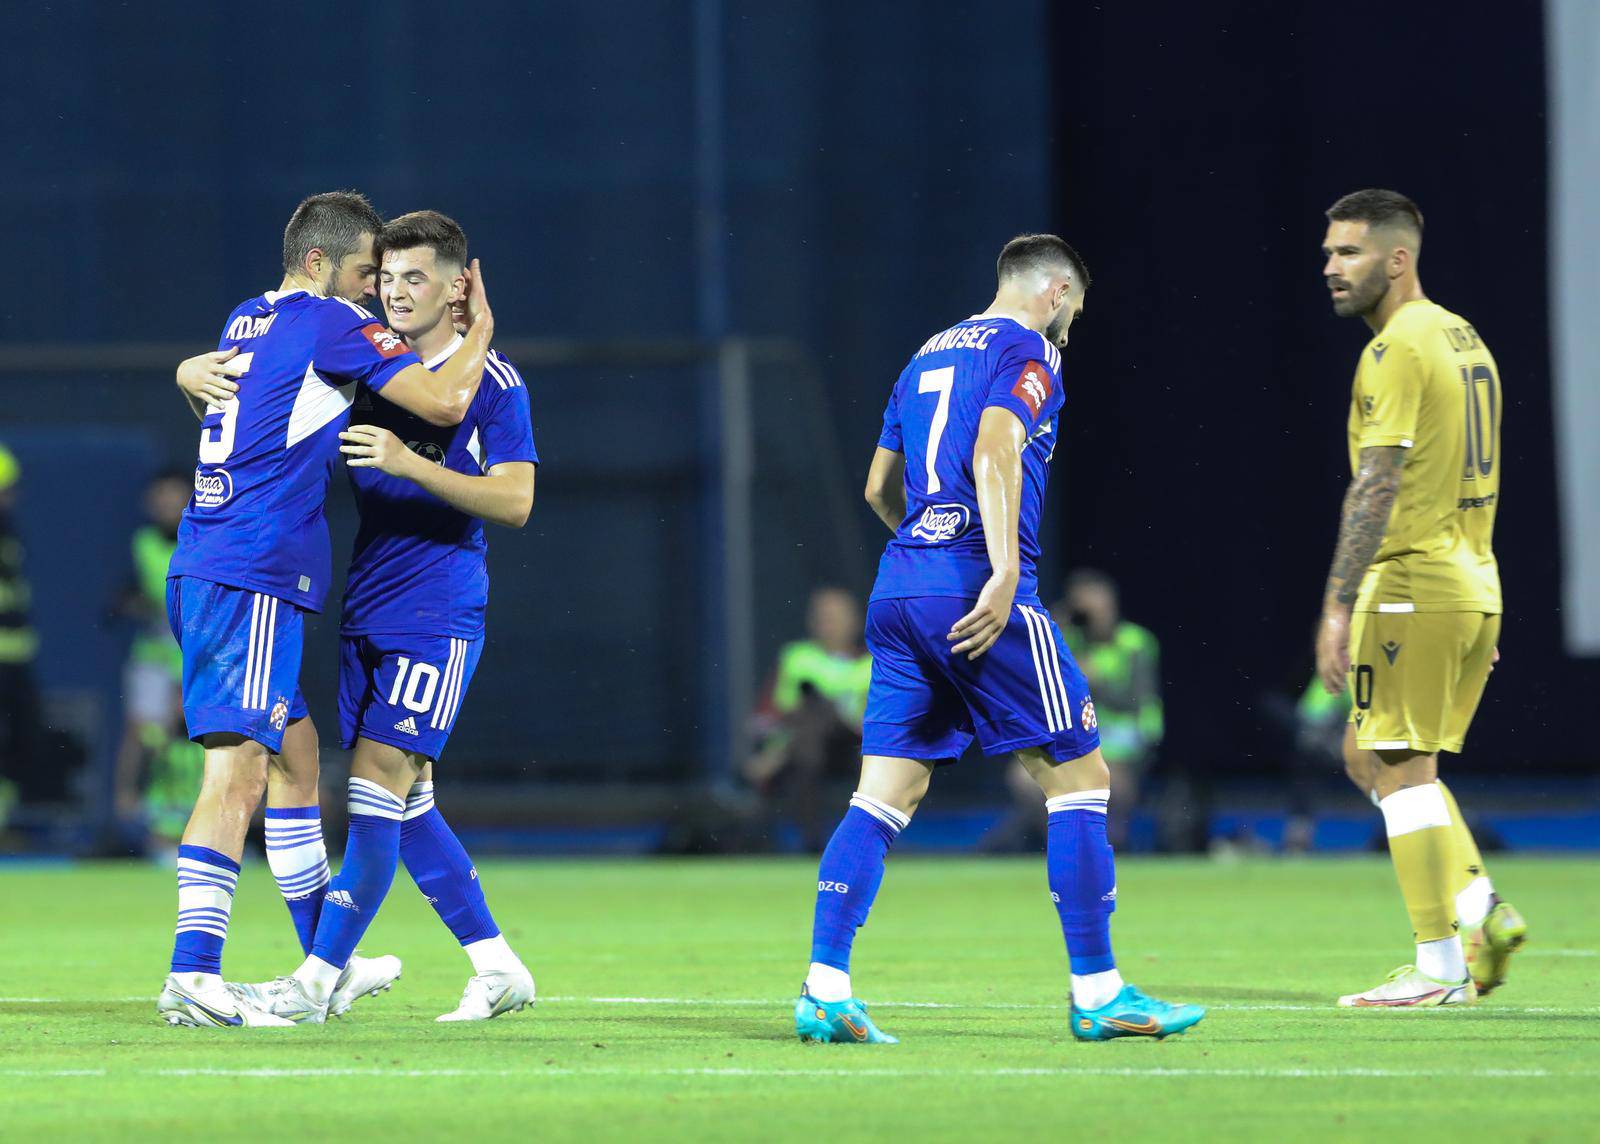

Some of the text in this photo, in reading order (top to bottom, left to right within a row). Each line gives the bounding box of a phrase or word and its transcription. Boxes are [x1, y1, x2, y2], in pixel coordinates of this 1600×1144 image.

[199, 351, 255, 464] 5
[917, 365, 955, 495] 7
[1458, 362, 1497, 481] 10
[387, 656, 440, 713] 10
[393, 723, 419, 736] adidas
[817, 880, 849, 894] DZG
